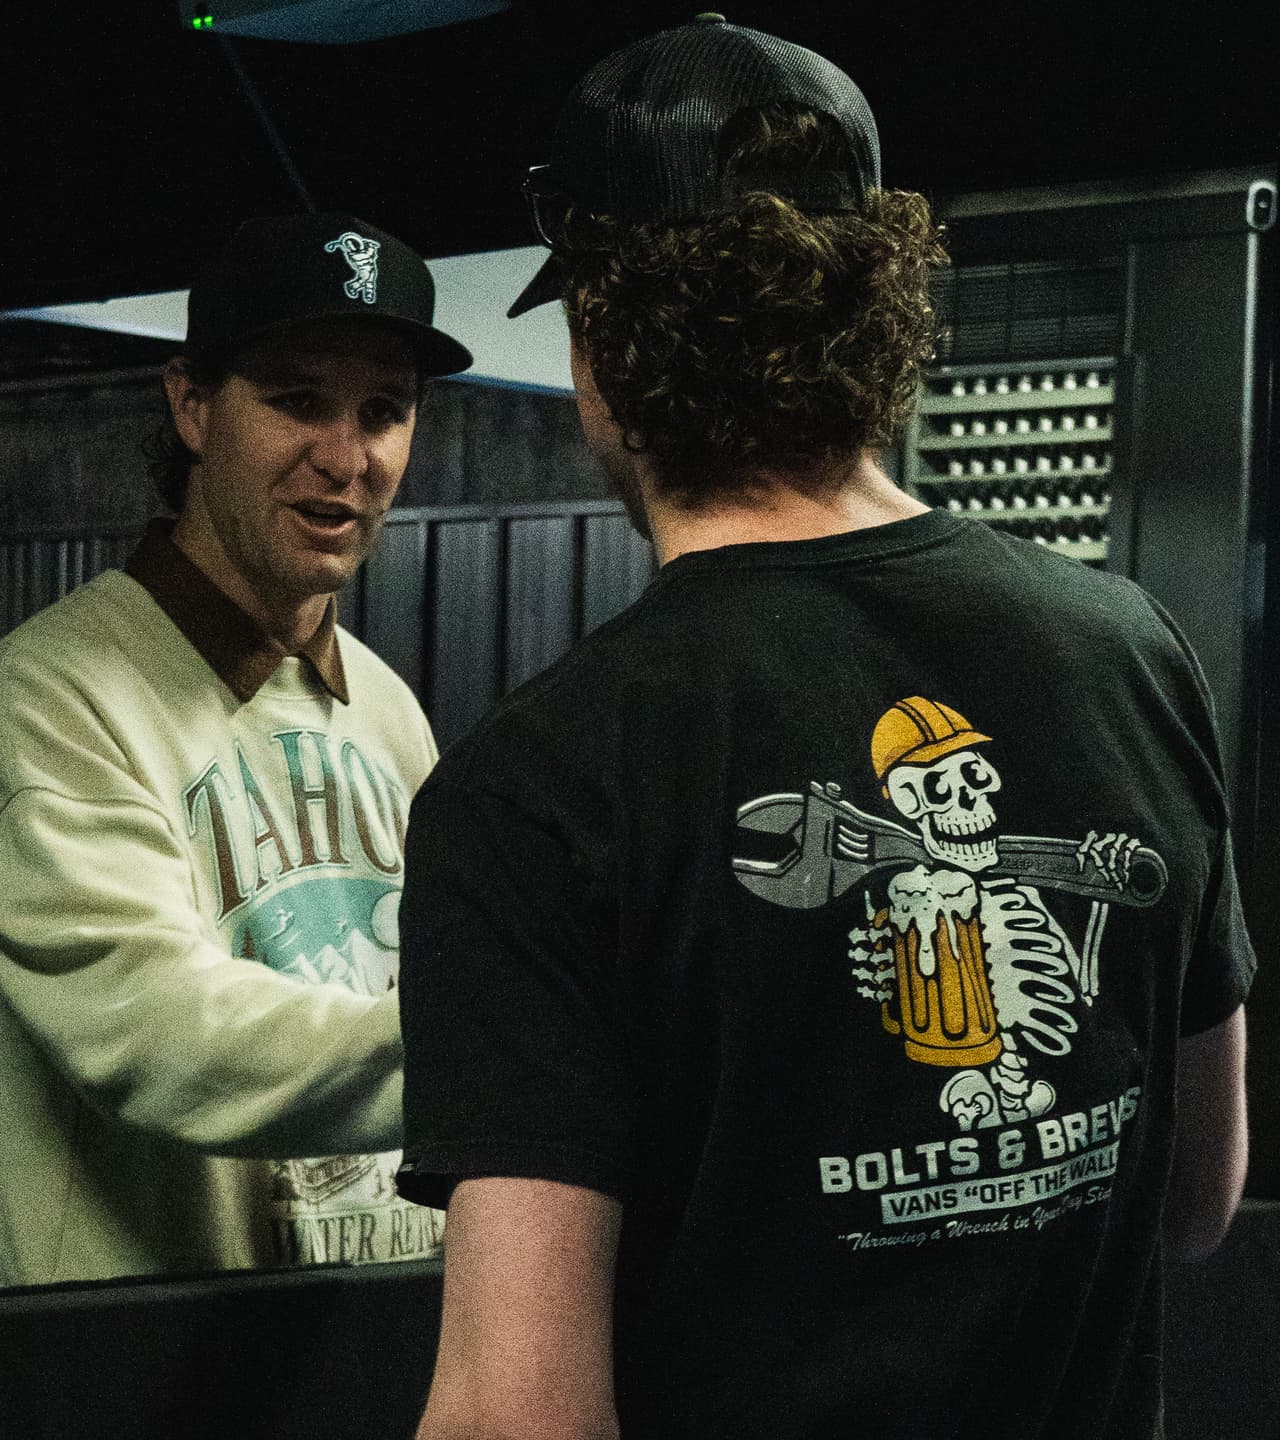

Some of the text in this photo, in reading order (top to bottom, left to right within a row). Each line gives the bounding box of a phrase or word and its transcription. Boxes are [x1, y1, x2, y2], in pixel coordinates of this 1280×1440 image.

[819, 1137, 980, 1194] BOLTS
[998, 1129, 1026, 1169] &
[889, 1188, 958, 1217] VANS
[1030, 1166, 1067, 1195] THE
[930, 1229, 943, 1240] a
[946, 1212, 1010, 1239] Wrench
[1013, 1215, 1030, 1230] in
